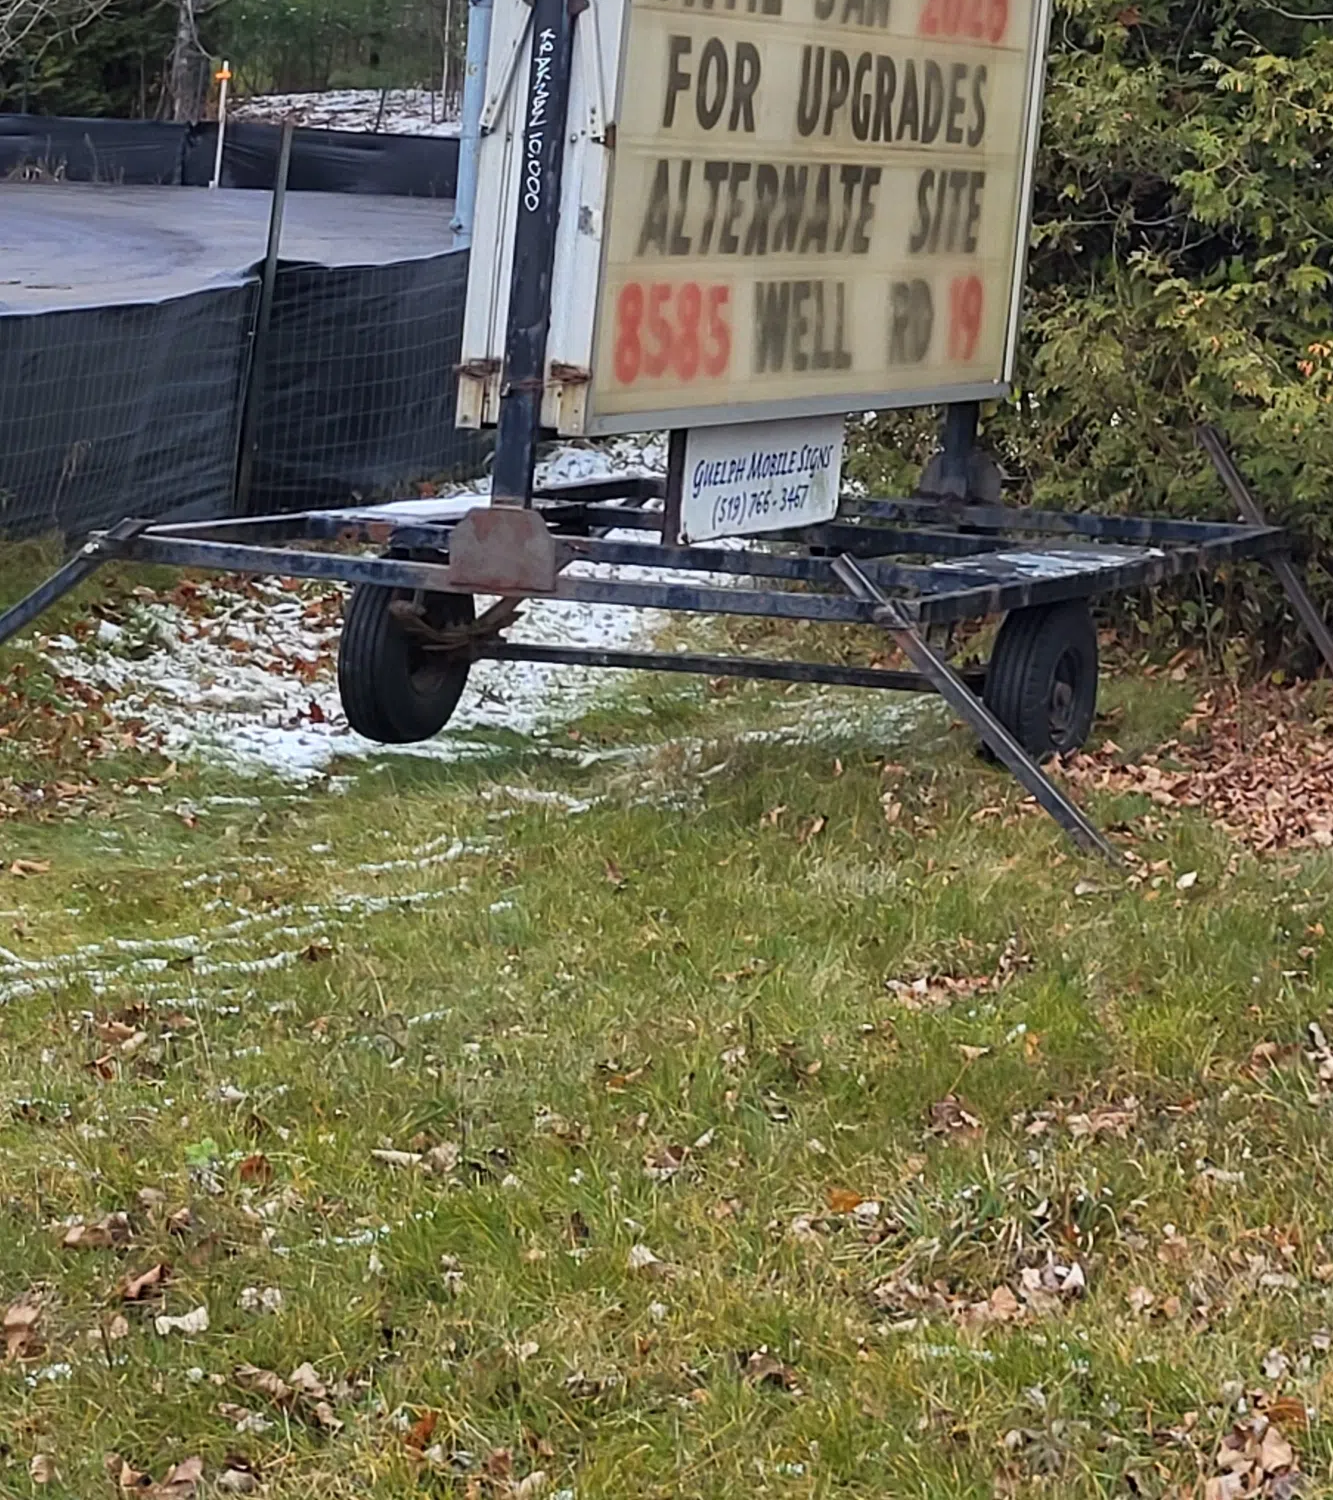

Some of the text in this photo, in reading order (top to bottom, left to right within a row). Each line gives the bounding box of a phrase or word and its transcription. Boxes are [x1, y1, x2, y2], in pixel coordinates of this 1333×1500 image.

[663, 35, 988, 148] FOR UPGRADES
[637, 159, 986, 257] ALTERNATE SITE
[614, 281, 732, 385] 8585
[755, 280, 853, 373] WELL
[947, 274, 984, 361] 19
[692, 459, 747, 499] GUELPH
[746, 451, 798, 482] MOBILE
[712, 491, 747, 531] (519)
